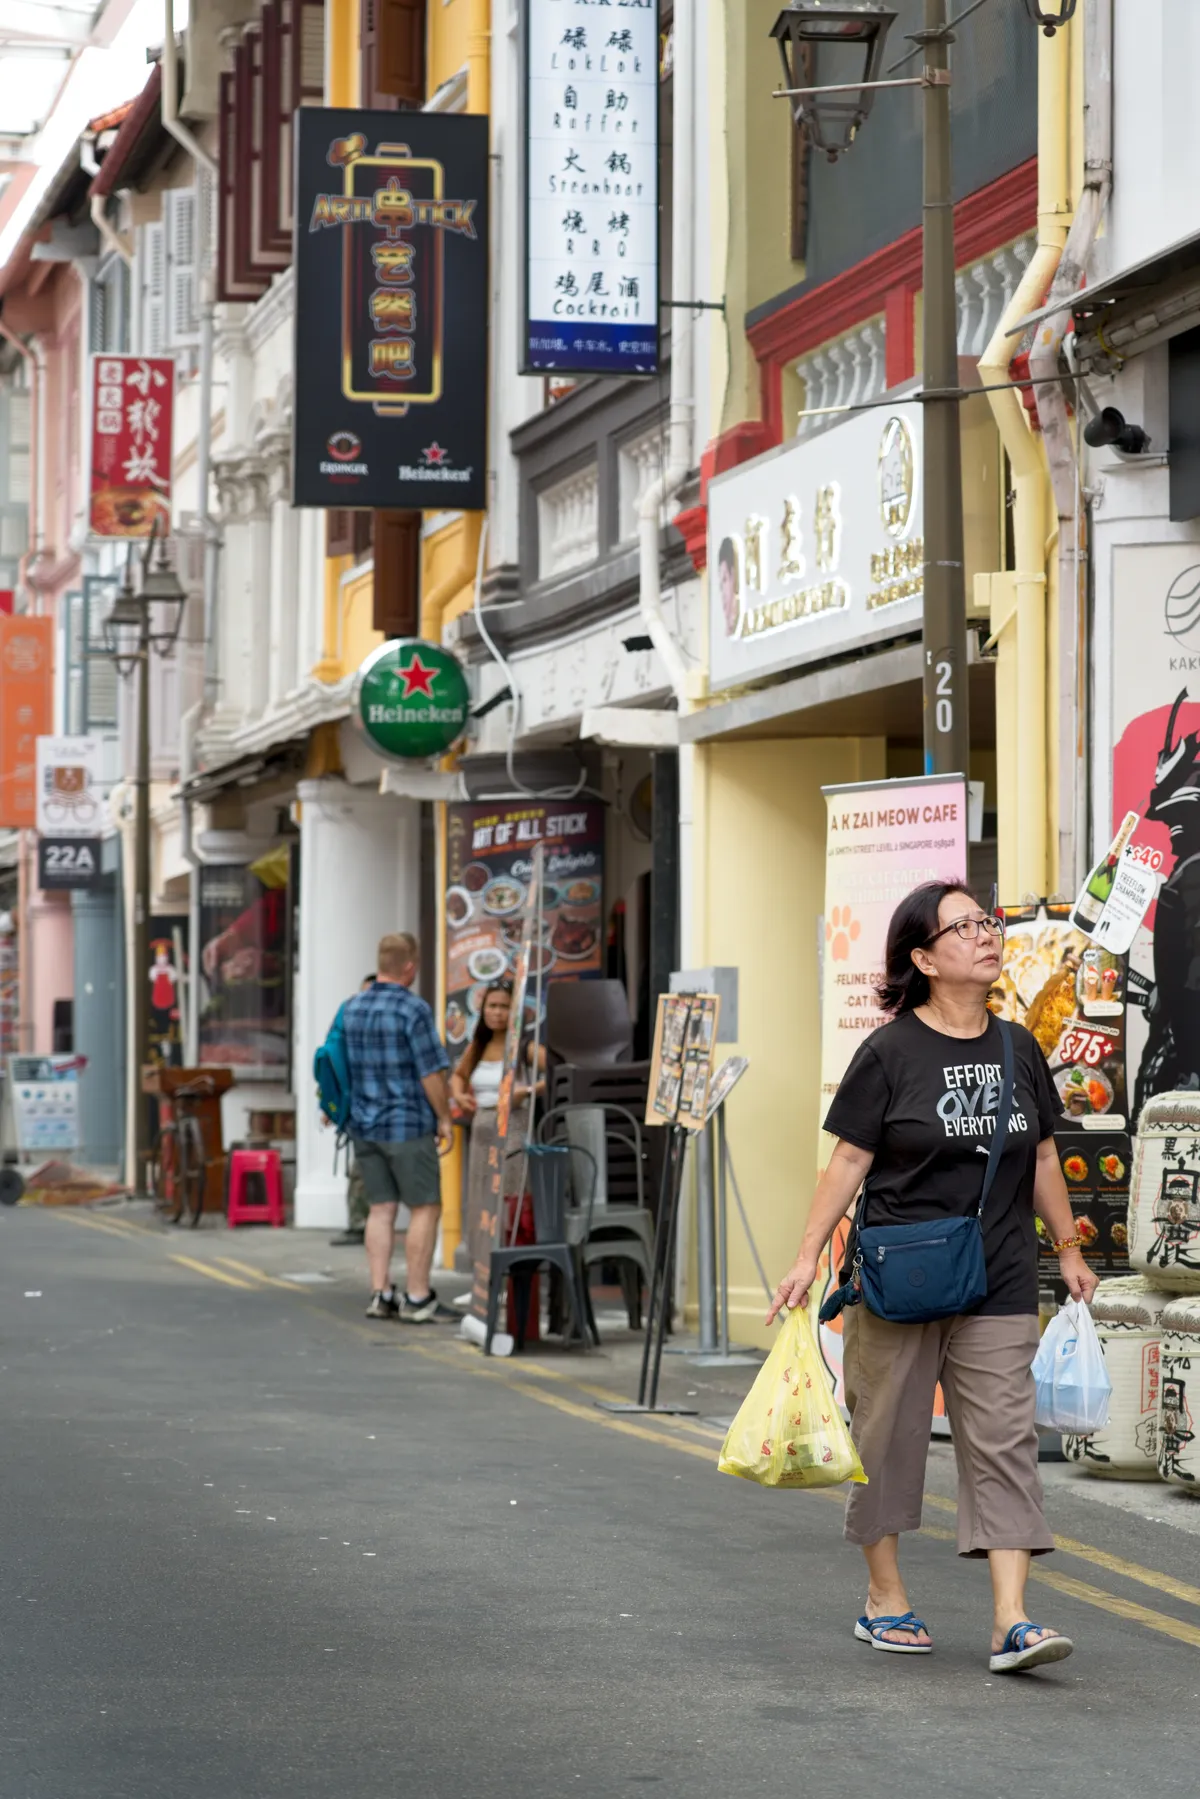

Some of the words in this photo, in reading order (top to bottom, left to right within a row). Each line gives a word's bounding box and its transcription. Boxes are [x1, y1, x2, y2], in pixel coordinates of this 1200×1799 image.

[564, 84, 629, 112] 自助
[562, 147, 632, 175] 火锅
[412, 199, 477, 240] TICK
[562, 209, 630, 237] 烧烤
[555, 271, 640, 298] 鸡尾酒
[553, 299, 640, 317] Cocktail
[320, 461, 368, 475] ERDINGER
[398, 466, 472, 482] Heineken
[1169, 656, 1200, 670] KAK
[936, 661, 953, 732] 20
[368, 704, 463, 723] Heineken
[495, 821, 514, 845] OF
[516, 818, 543, 841] ALL
[546, 812, 588, 837] STICK
[831, 814, 838, 831] A
[842, 813, 850, 830] K
[853, 810, 873, 829] ZAI
[877, 807, 920, 827] MEOW
[922, 803, 958, 823] CAFE
[45, 846, 95, 869] 22A
[853, 843, 876, 855] STREET
[876, 841, 894, 852] LEVEL
[899, 840, 932, 851] SINGAPORE
[1125, 846, 1161, 870] +$40
[893, 868, 920, 884] CAFE
[924, 866, 938, 882] IN
[1115, 883, 1147, 908] CHAMPAGNE
[834, 973, 867, 986] -FELINE
[844, 995, 868, 1007] -CAT
[838, 1016, 886, 1029] ALLEVIATE
[943, 1064, 1001, 1089] EFFORT
[944, 1113, 1028, 1137] EVERYTNG
